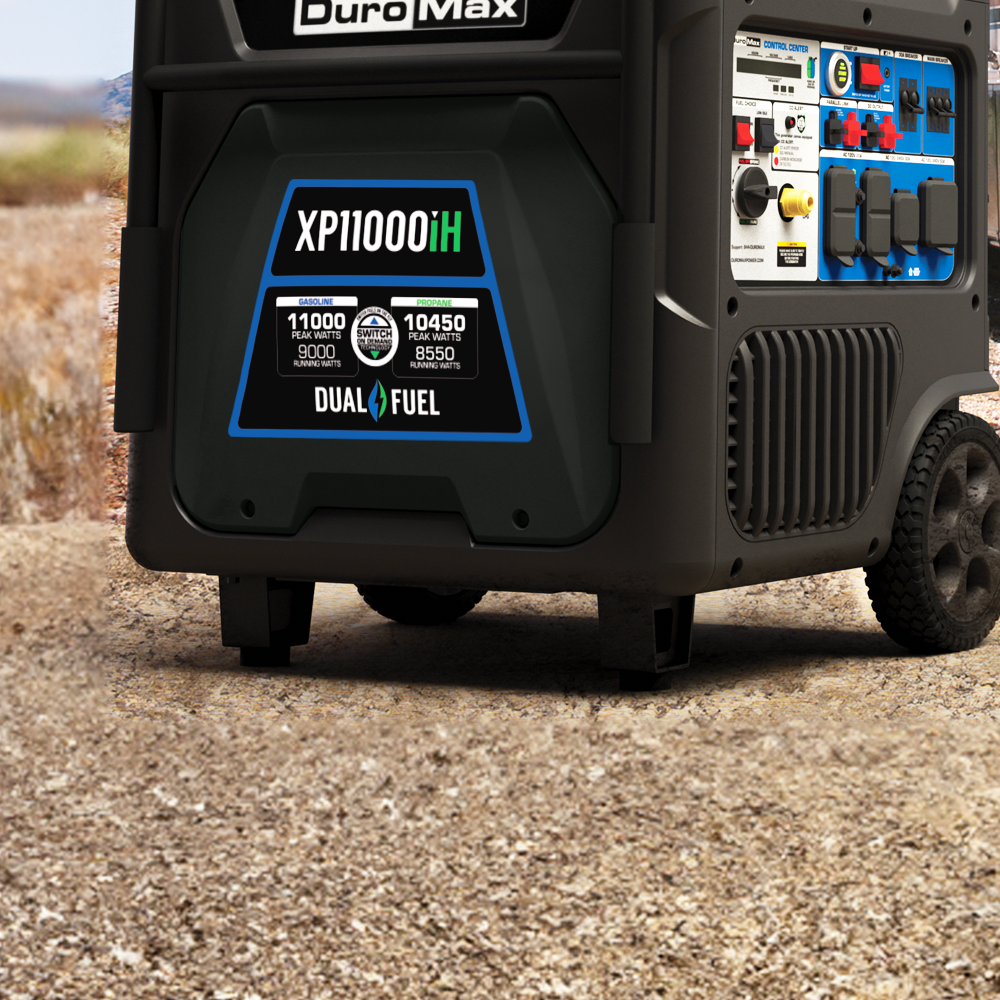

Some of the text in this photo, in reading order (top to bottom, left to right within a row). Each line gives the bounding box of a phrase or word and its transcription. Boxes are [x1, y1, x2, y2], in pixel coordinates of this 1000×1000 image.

[764, 40, 788, 51] CONTROL
[788, 43, 809, 53] CENTER
[295, 210, 461, 252] XP11000iH
[299, 298, 333, 306] GASOLINE
[416, 299, 453, 307] PROPANE
[287, 312, 346, 330] 11000
[403, 313, 466, 332] 10450
[291, 331, 342, 340] PEAK WATTS
[357, 329, 392, 338] SWITCH
[408, 332, 462, 342] PEAK WATTS
[298, 344, 336, 359] 9000
[415, 345, 455, 361] 8550
[293, 360, 342, 368] RUNNING WATTS
[409, 361, 461, 370] RUNNING WATTS
[314, 386, 440, 416] DUAL FUEL
